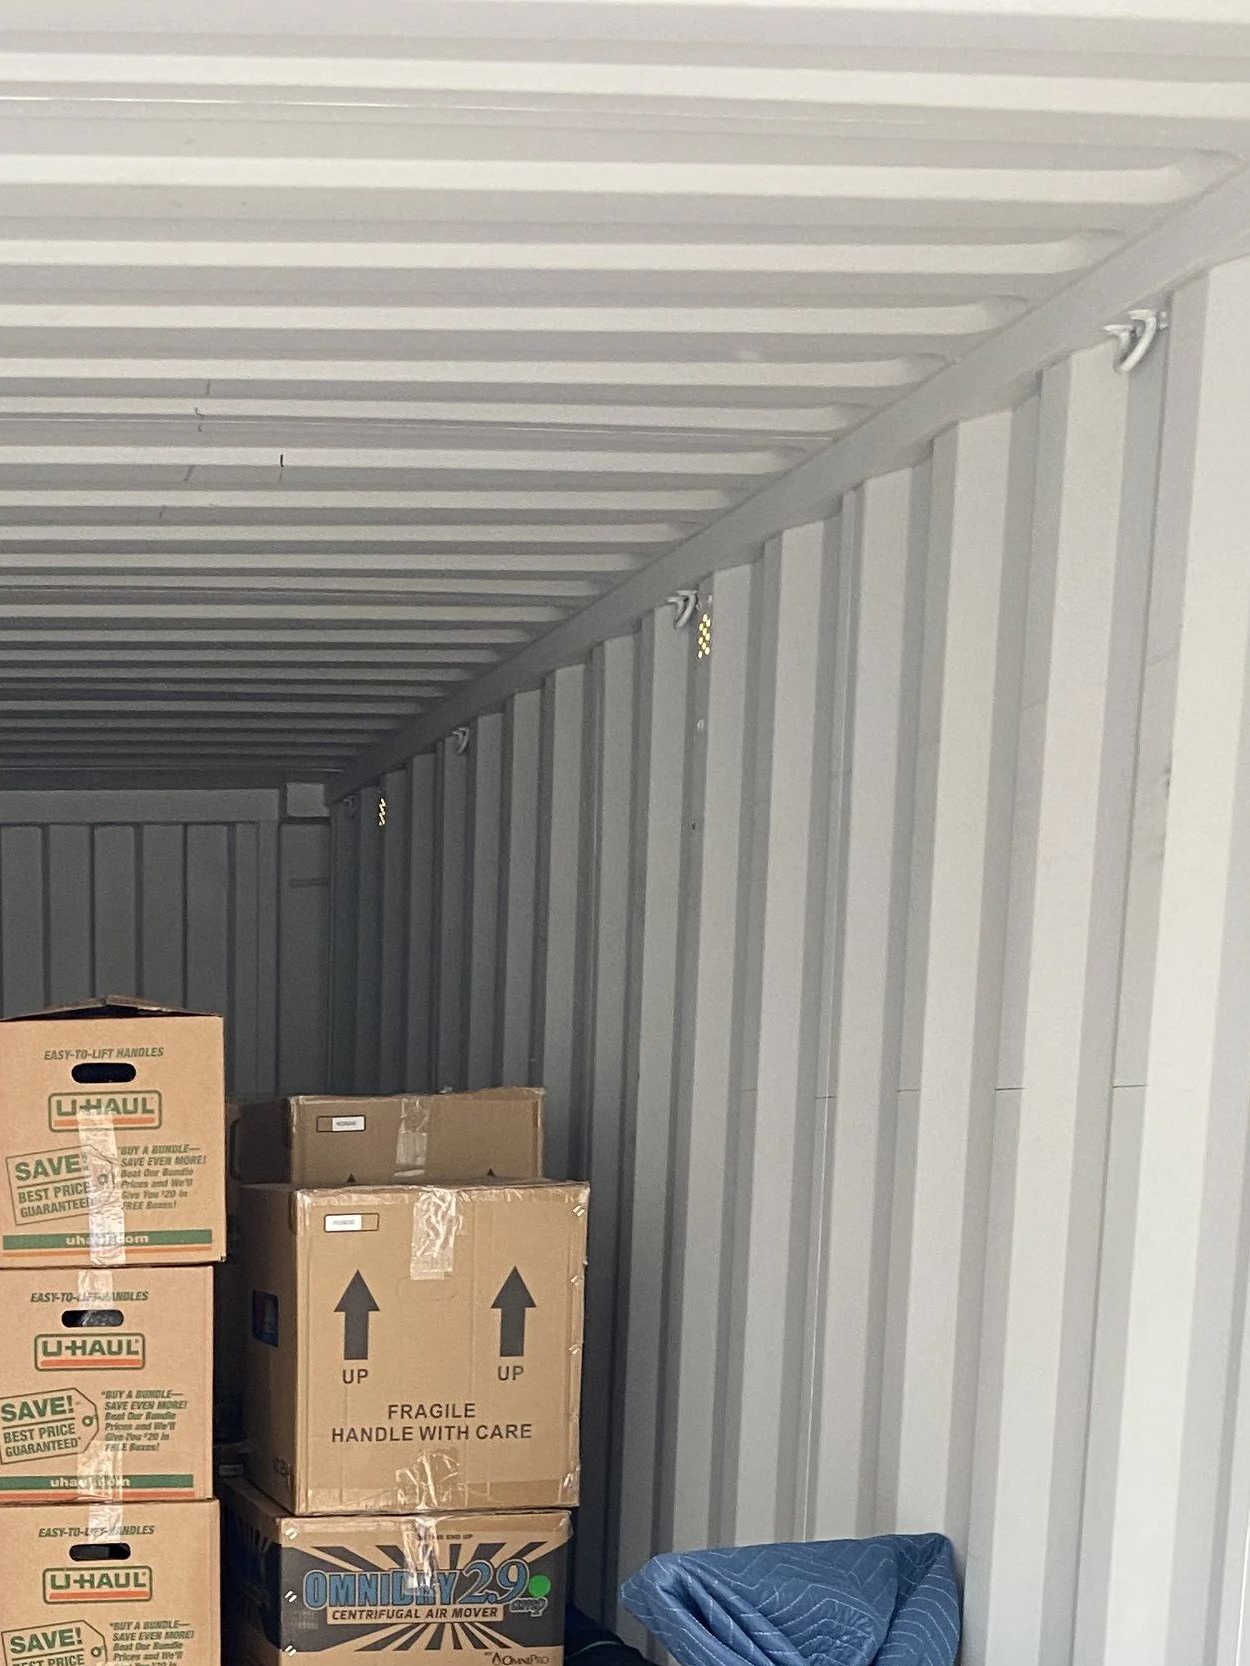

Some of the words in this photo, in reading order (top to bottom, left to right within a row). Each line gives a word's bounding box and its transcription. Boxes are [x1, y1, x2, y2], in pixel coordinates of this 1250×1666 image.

[117, 1047, 164, 1058] HANDLES
[56, 1097, 154, 1117] U-HAUL
[18, 1189, 51, 1204] BEST
[54, 1183, 90, 1197] PRICE
[42, 1339, 139, 1357] U-HAUL
[342, 1369, 369, 1384] UP
[498, 1366, 524, 1381] UP
[1, 1395, 74, 1422] SAVE!
[131, 1401, 155, 1409] EVEN
[388, 1403, 476, 1419] FRAGILE
[4, 1429, 34, 1444] BEST
[39, 1424, 75, 1438] PRICE
[331, 1426, 414, 1443] HANDLE
[418, 1425, 470, 1441] WITH
[475, 1423, 532, 1440] CARE
[50, 1572, 146, 1589] U-HAUL
[332, 1608, 421, 1620] CENTRIFUGAL
[425, 1607, 447, 1619] AIR
[452, 1607, 498, 1618] MOVER
[10, 1627, 82, 1654] SAVE!
